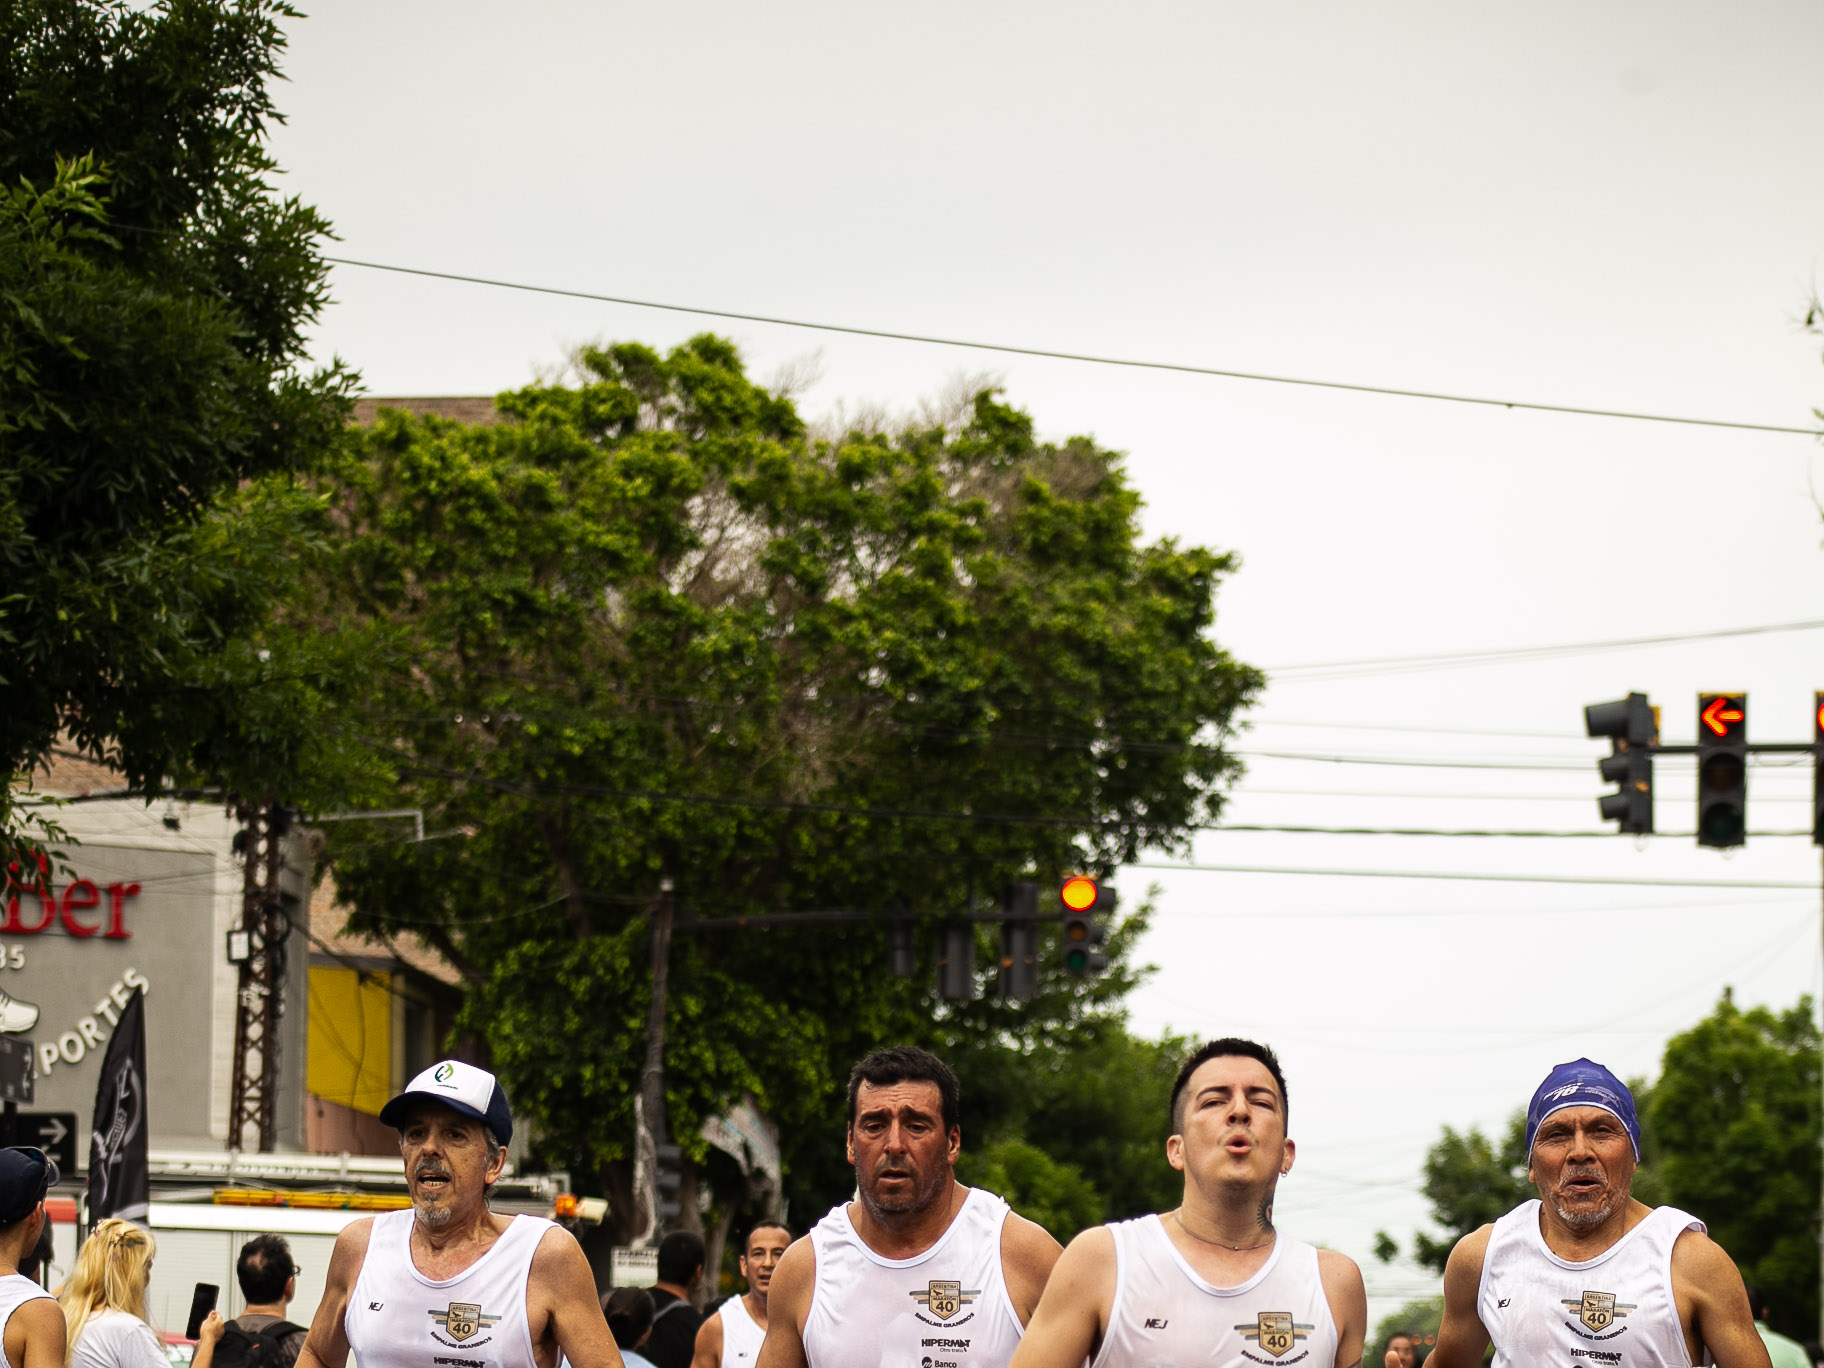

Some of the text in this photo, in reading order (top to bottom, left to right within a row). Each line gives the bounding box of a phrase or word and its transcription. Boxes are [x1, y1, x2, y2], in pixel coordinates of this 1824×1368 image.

[37, 967, 150, 1076] PORTES
[936, 1301, 954, 1312] 40
[914, 1312, 974, 1328] EMPALME GRANEROS
[1144, 1318, 1168, 1329] NEJ
[1587, 1313, 1607, 1325] 40
[452, 1323, 471, 1334] 40
[1564, 1321, 1628, 1340] EMPALME GRANEROS
[430, 1331, 492, 1349] EMPALME GRANEROS
[1267, 1335, 1287, 1348] 40
[934, 1360, 958, 1368] Banco
[1240, 1350, 1309, 1366] EMPALME GRANEROS
